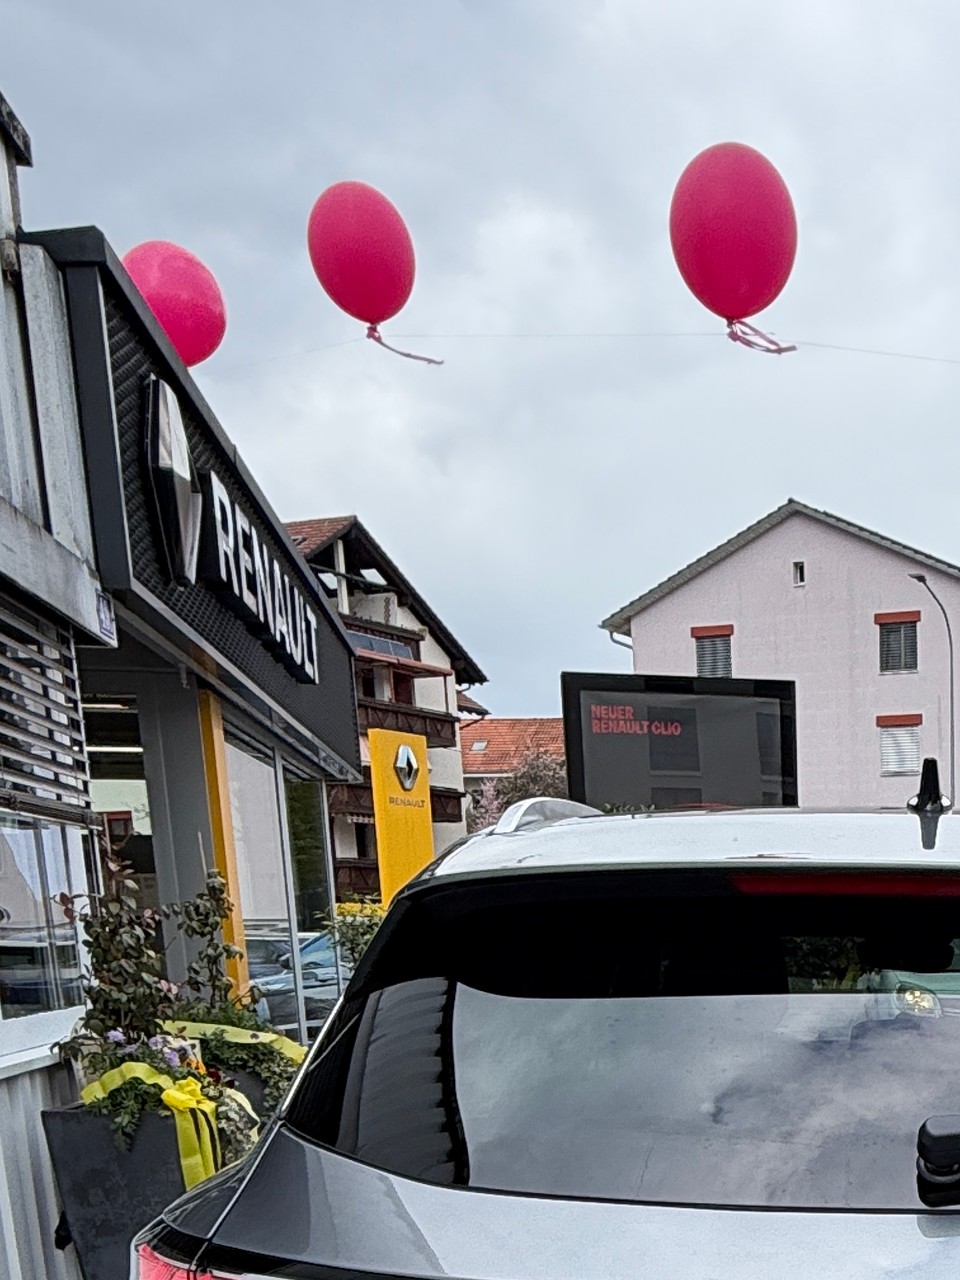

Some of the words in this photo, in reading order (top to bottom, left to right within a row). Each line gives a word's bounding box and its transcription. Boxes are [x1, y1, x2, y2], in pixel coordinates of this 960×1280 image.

[210, 470, 319, 684] RENAULT
[590, 704, 634, 719] NEUER
[591, 719, 649, 734] RENAULT
[651, 721, 682, 736] CLIO
[388, 796, 426, 808] RENAULT
